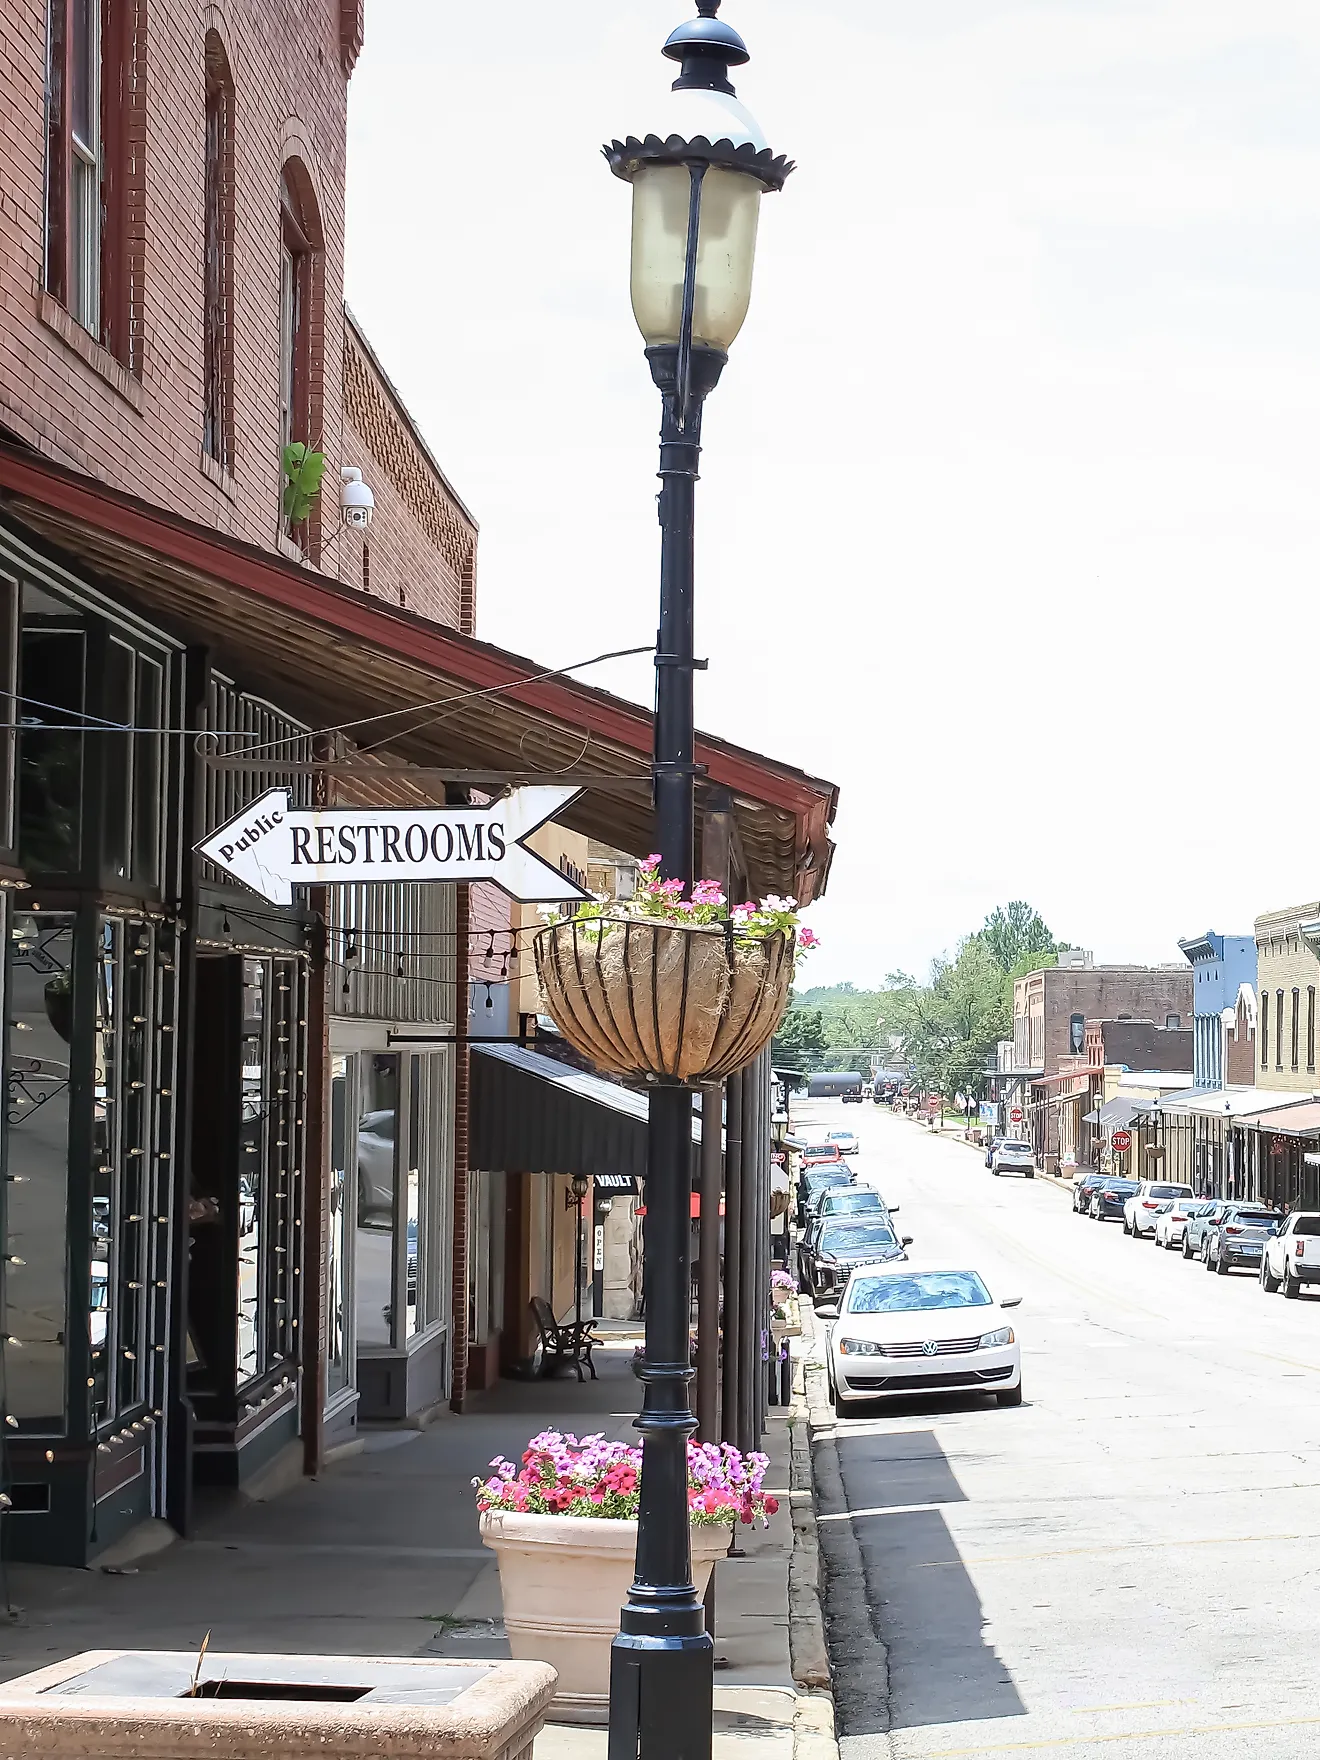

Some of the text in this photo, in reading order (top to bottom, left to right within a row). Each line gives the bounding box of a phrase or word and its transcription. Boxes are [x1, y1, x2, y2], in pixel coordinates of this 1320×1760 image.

[218, 811, 506, 865] Public RESTROOMS
[595, 1174, 632, 1187] VAULT
